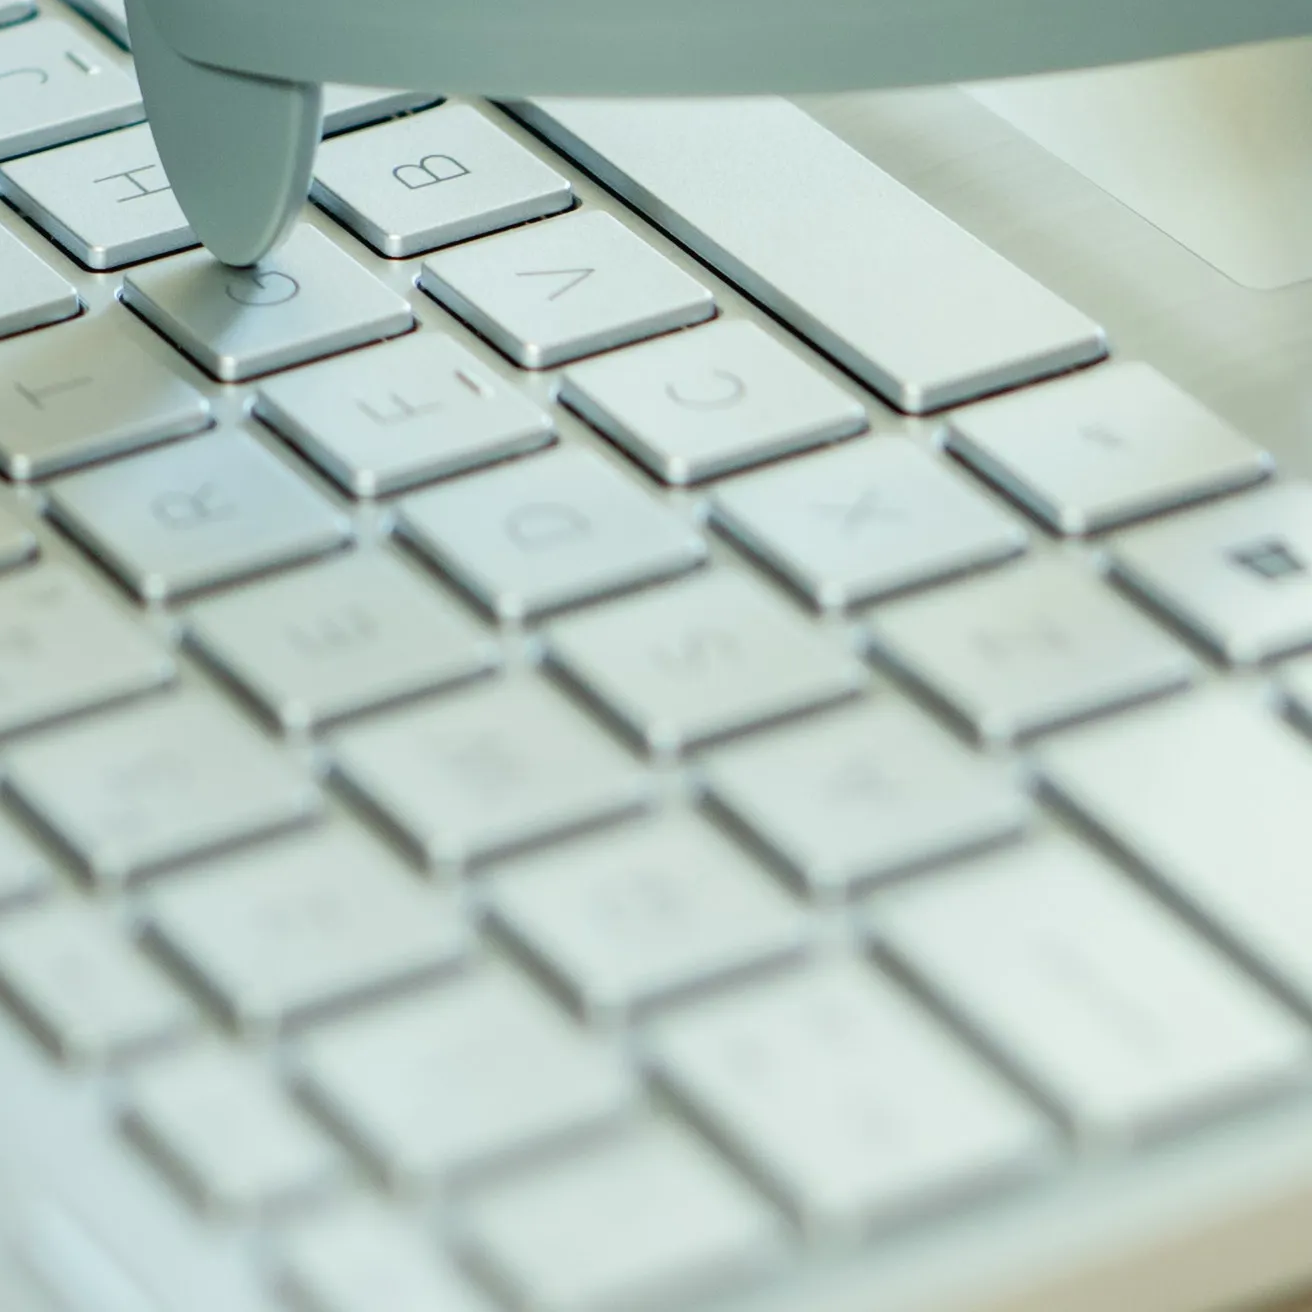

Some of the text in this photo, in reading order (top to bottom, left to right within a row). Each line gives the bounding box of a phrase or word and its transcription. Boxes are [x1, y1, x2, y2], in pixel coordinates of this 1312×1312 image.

[92, 163, 172, 204] H
[392, 153, 471, 191] B
[224, 269, 302, 308] G
[515, 268, 596, 301] V
[12, 376, 95, 411] T
[352, 388, 446, 426] F
[663, 368, 747, 413] C
[149, 481, 237, 531] R
[500, 500, 592, 553] D
